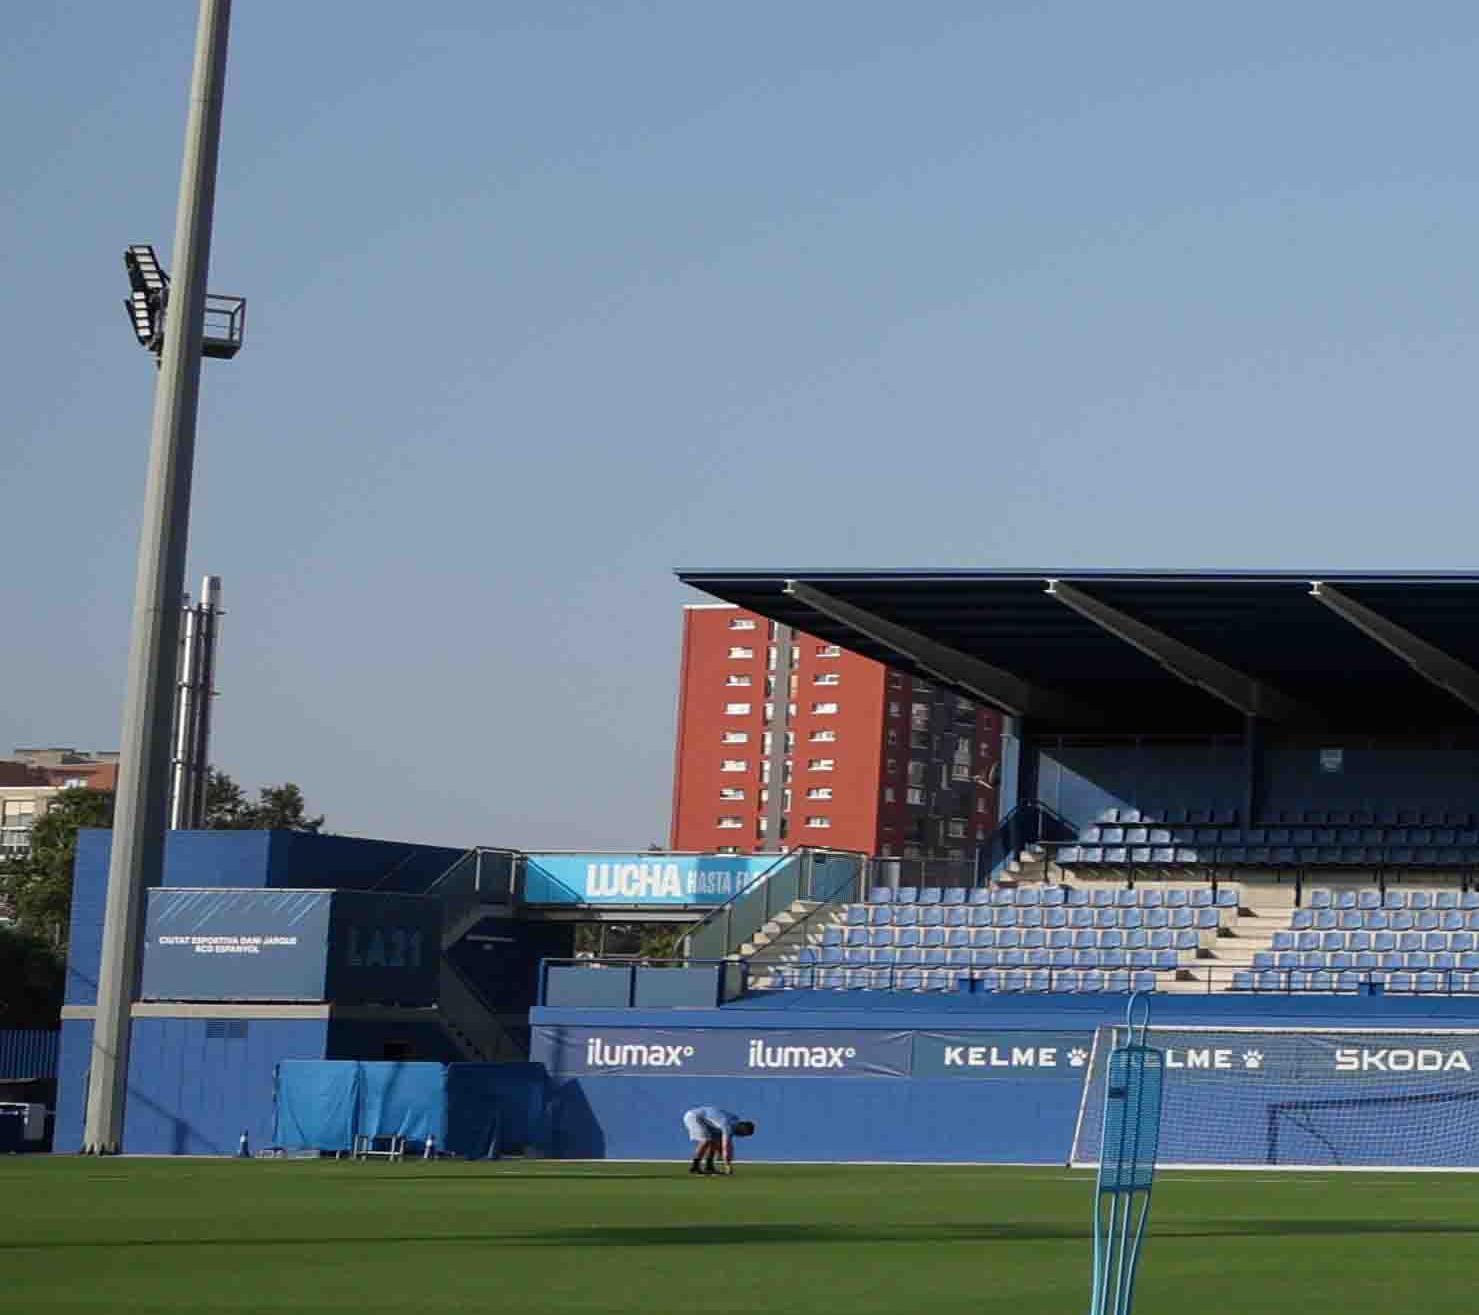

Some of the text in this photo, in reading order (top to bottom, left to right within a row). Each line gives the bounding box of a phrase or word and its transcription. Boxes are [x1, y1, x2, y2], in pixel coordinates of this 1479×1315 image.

[586, 863, 682, 896] LUCHA
[687, 870, 731, 894] HASTA
[159, 936, 190, 945] CIUTAT
[191, 936, 239, 945] ESPORTIVA
[944, 1046, 1057, 1067] KELME
